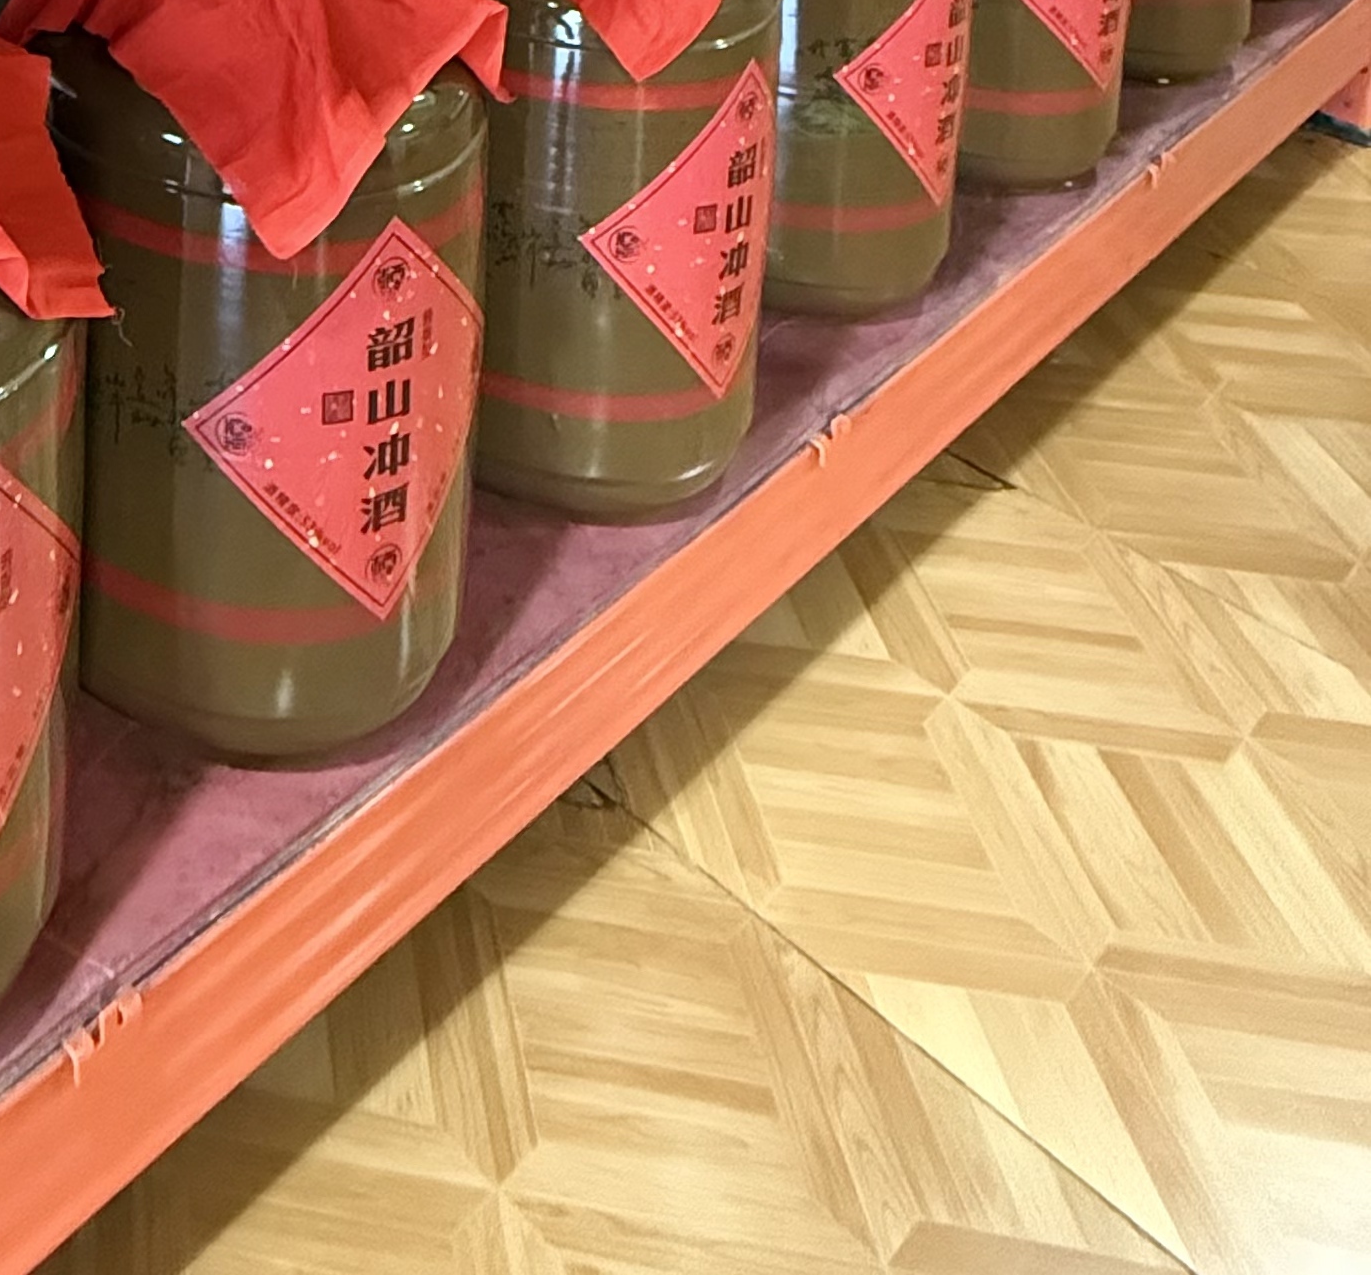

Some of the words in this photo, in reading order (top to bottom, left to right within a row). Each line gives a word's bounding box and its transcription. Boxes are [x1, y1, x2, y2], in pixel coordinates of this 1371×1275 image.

[711, 142, 757, 326] 韶山冲酒
[359, 316, 416, 535] 韶山冲酒
